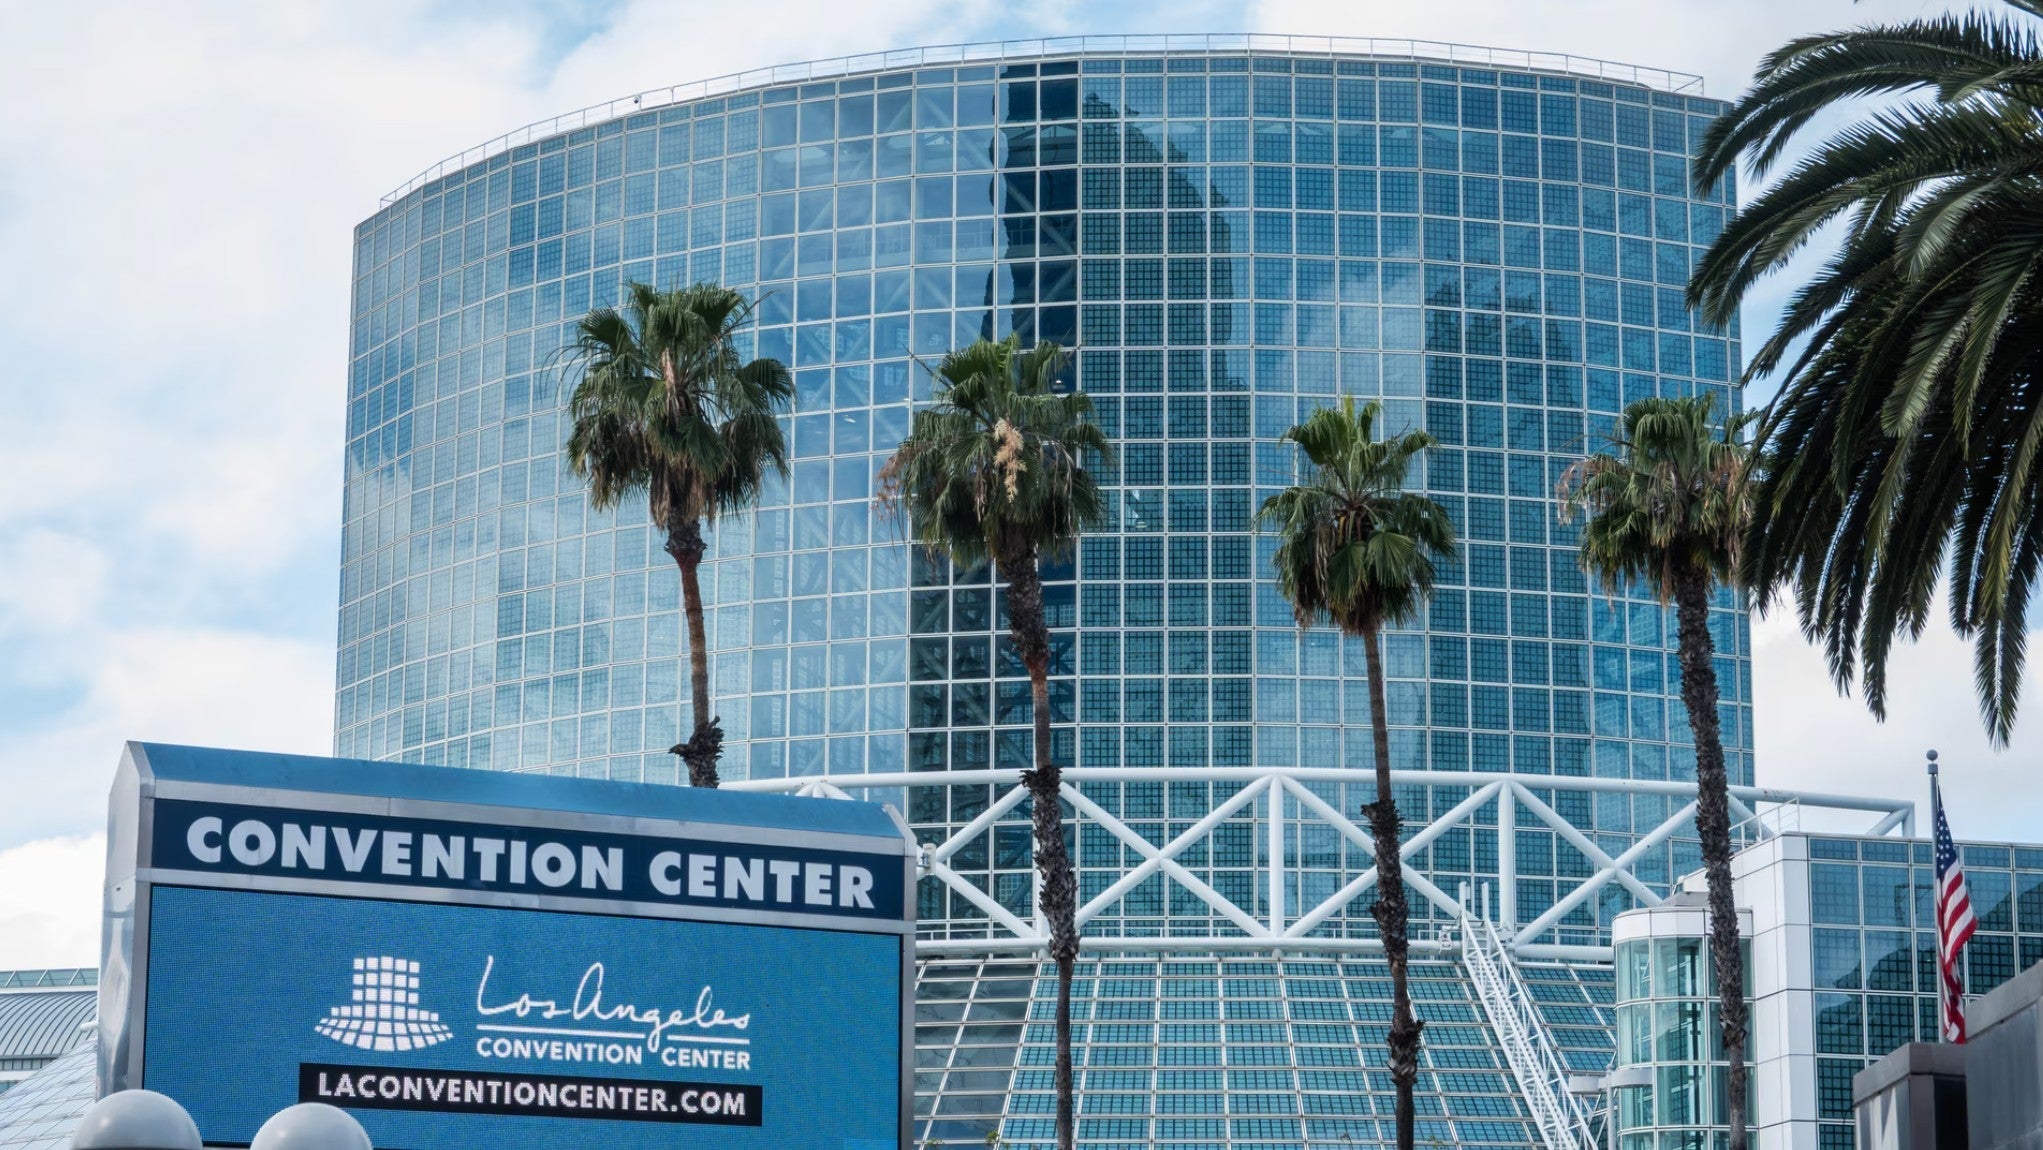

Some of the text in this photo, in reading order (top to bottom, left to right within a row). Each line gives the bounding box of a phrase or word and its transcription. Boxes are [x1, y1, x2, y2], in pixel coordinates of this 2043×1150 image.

[186, 815, 875, 909] CONVENTION CENTER
[476, 955, 750, 1053] Los Angeles
[476, 1036, 751, 1071] CONVENTION CENTER
[318, 1072, 746, 1116] LACONVENTIONCENTER.COM
